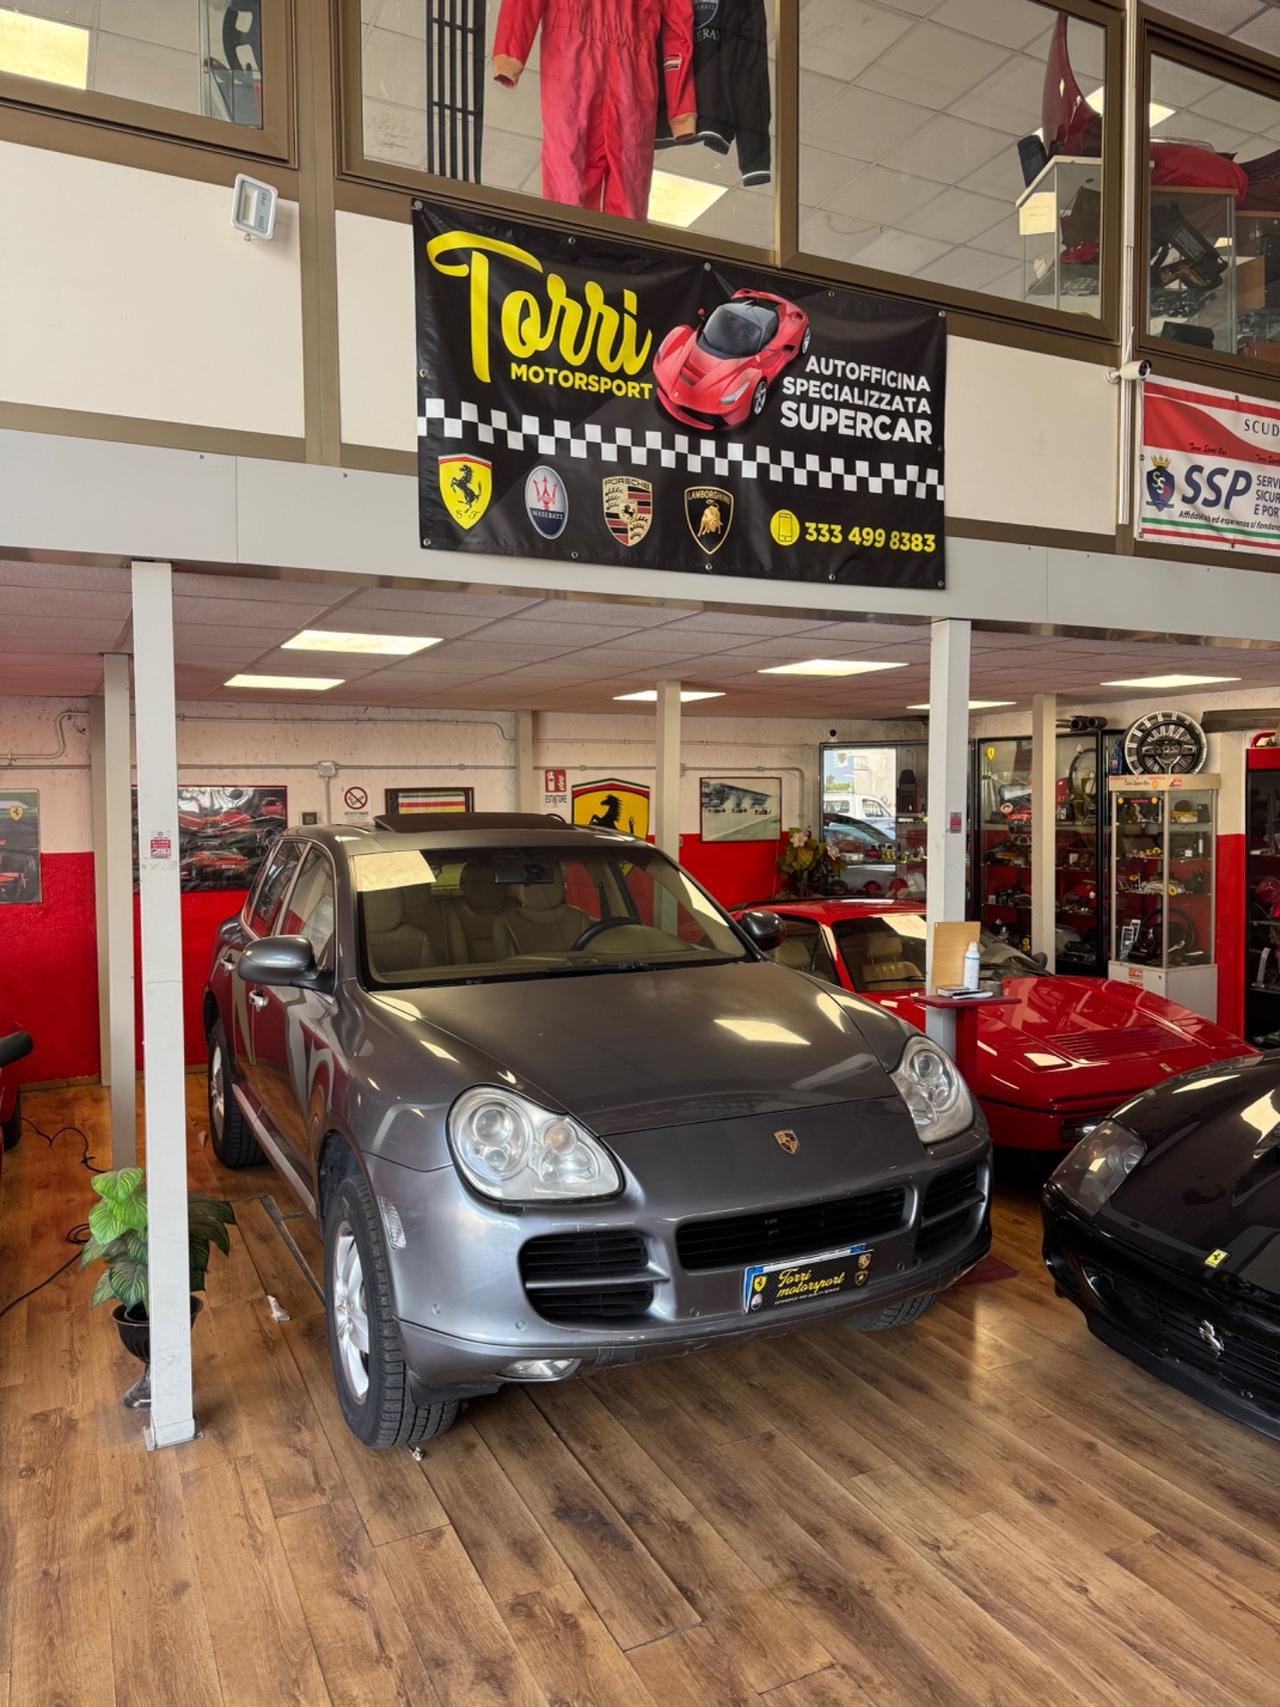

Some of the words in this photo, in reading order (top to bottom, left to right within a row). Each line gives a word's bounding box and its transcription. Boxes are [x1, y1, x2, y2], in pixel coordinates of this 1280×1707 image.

[426, 230, 654, 383] Torri
[510, 363, 654, 400] MOTORSPORT
[805, 355, 931, 392] AUTOFFICINA
[782, 376, 932, 415] SPECIALIZZATA
[780, 399, 933, 445] SUPERCAR
[604, 477, 652, 491] PORSCHE
[688, 489, 731, 505] LAMBORGHINI
[1181, 463, 1253, 510] SSP
[1254, 504, 1260, 515] E
[805, 522, 844, 544] 333
[848, 526, 885, 549] 499
[889, 531, 936, 553] 8383
[776, 1272, 845, 1298] motorsport
[778, 1267, 812, 1288] Torri
